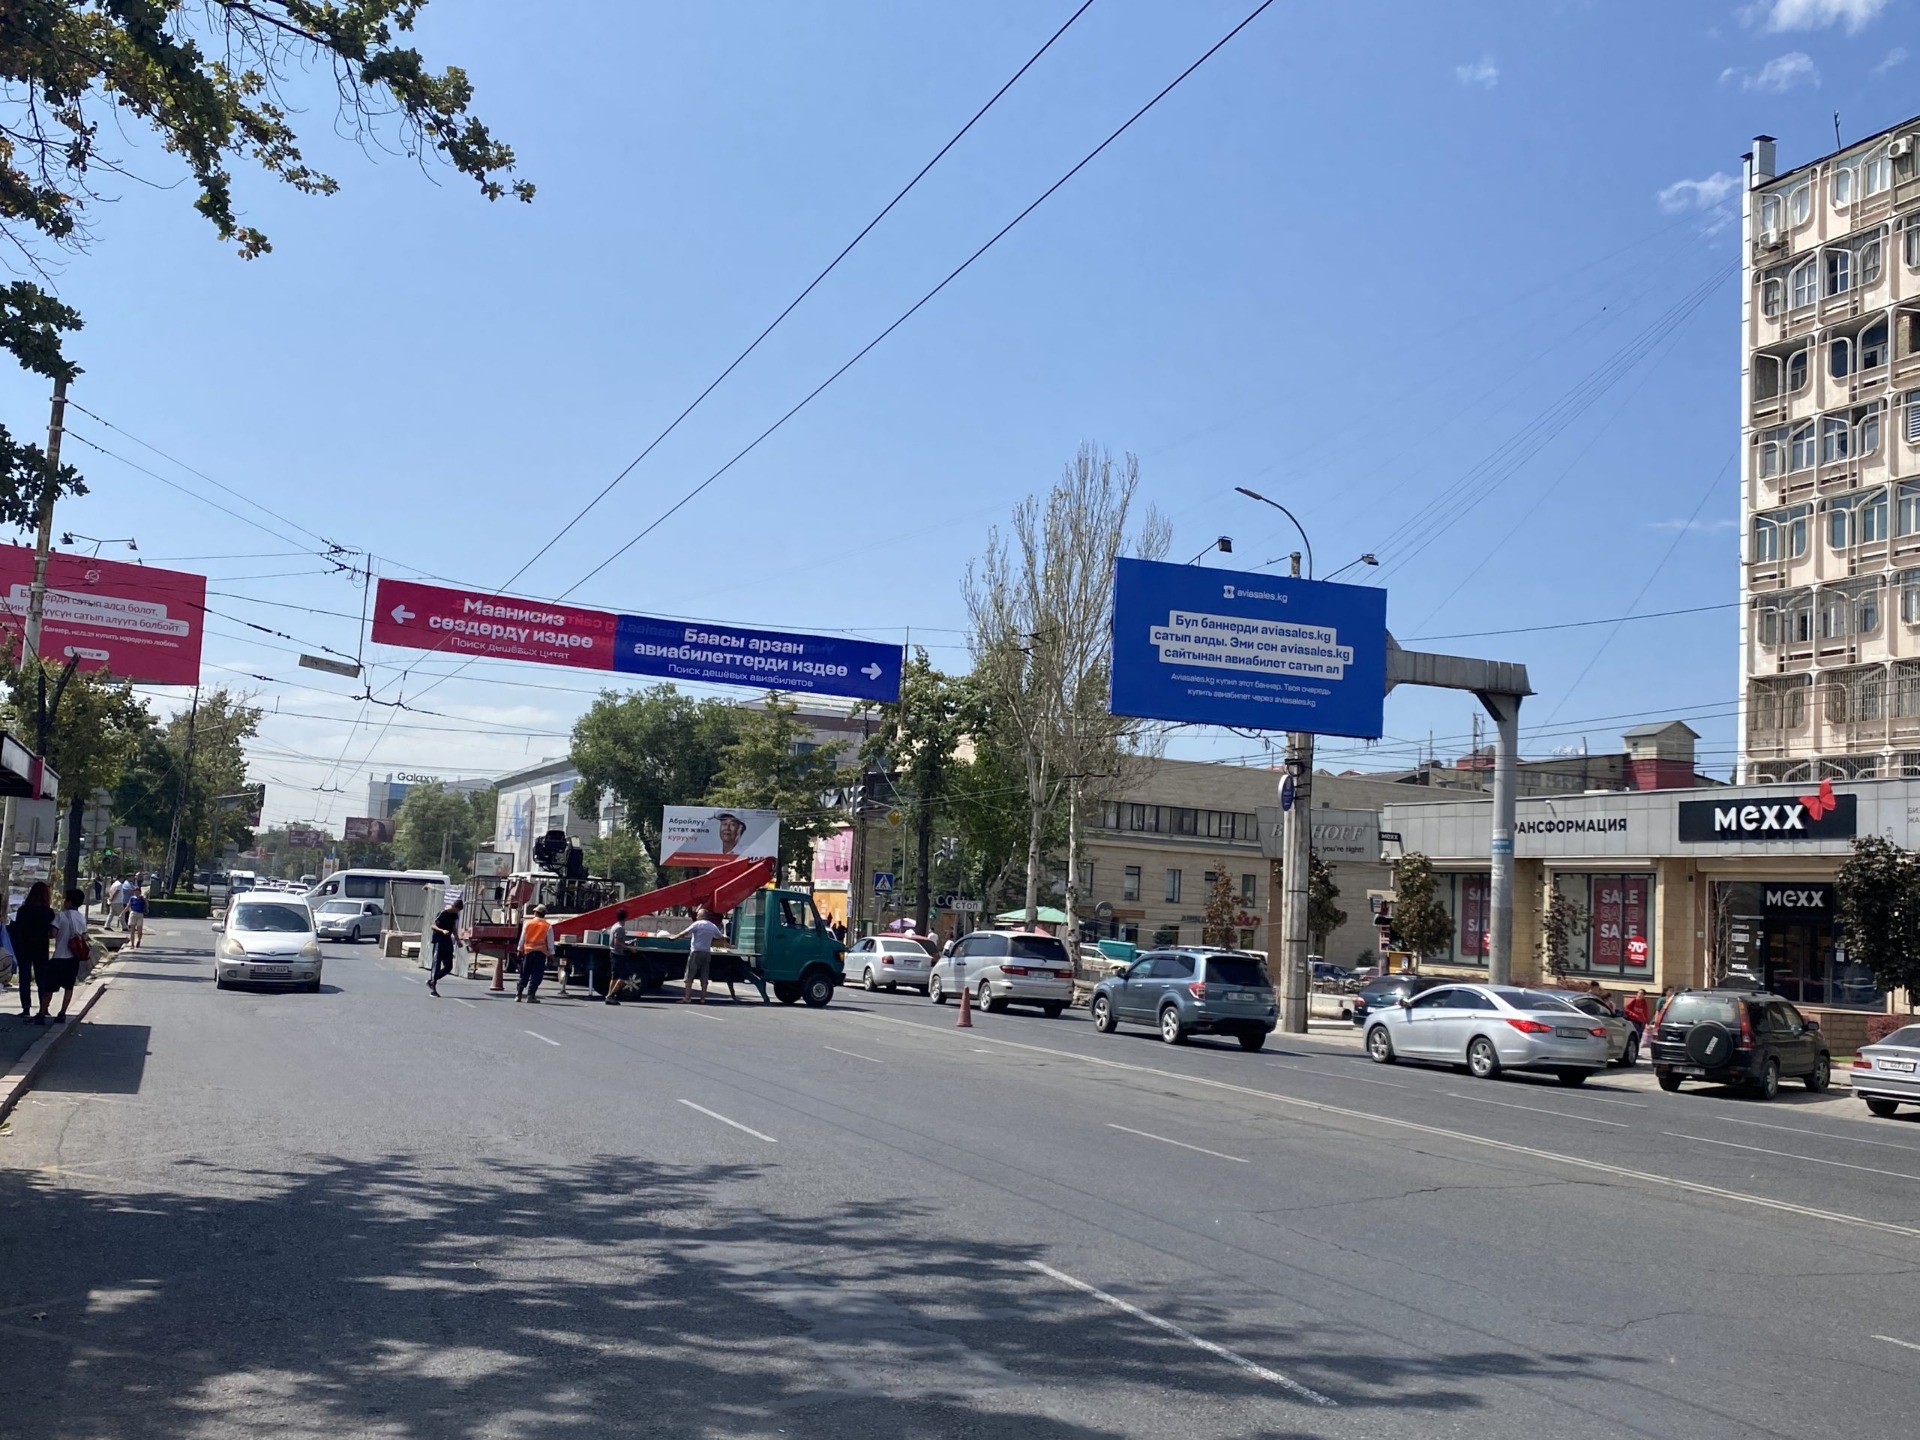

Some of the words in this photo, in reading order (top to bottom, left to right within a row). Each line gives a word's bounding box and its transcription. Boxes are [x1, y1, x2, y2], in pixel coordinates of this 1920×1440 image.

[20, 589, 70, 604] Баерди
[103, 602, 126, 611] алса
[1237, 589, 1288, 604] aviasales.kg
[74, 612, 104, 622] сатып
[106, 617, 138, 627] алууга
[463, 598, 565, 627] Маанисиз
[429, 616, 530, 644] сөздөрдү
[532, 630, 593, 648] издөө
[1175, 615, 1198, 628] Бул
[1201, 617, 1258, 635] баннерди
[1261, 625, 1331, 644] aviasales.kg
[451, 637, 486, 650] Поиск
[488, 643, 538, 657] дешёвых
[539, 649, 570, 660] цитат
[684, 628, 745, 649] Баасы
[748, 638, 804, 655] арзан
[1154, 631, 1191, 643] сатып
[1194, 636, 1227, 647] алды.
[1230, 637, 1255, 650] Эми
[1257, 642, 1278, 652] сен
[1280, 643, 1350, 661] aviasales.kg
[634, 642, 788, 671] авиабилеттерди
[792, 660, 848, 678] издөө
[1164, 648, 1222, 662] сайтынан
[1224, 654, 1286, 669] авиабилет
[1288, 661, 1323, 673] сатып
[1325, 665, 1339, 674] ал
[668, 664, 701, 676] Поиск
[702, 668, 748, 681] дешёвых
[749, 674, 814, 688] авиабилетов
[1171, 673, 1215, 685] Aviasales.kg
[1215, 678, 1237, 686] купил
[1238, 680, 1253, 688] этот
[1283, 683, 1300, 692] Твоя
[1302, 686, 1331, 695] очередь
[1187, 689, 1212, 697] купить
[1213, 691, 1250, 700] авиабилет
[1252, 694, 1274, 703] через
[1274, 697, 1316, 708] aviasales.kg
[1323, 845, 1344, 853] you're
[1602, 889, 1638, 904] SALE
[1600, 923, 1638, 939] SALE
